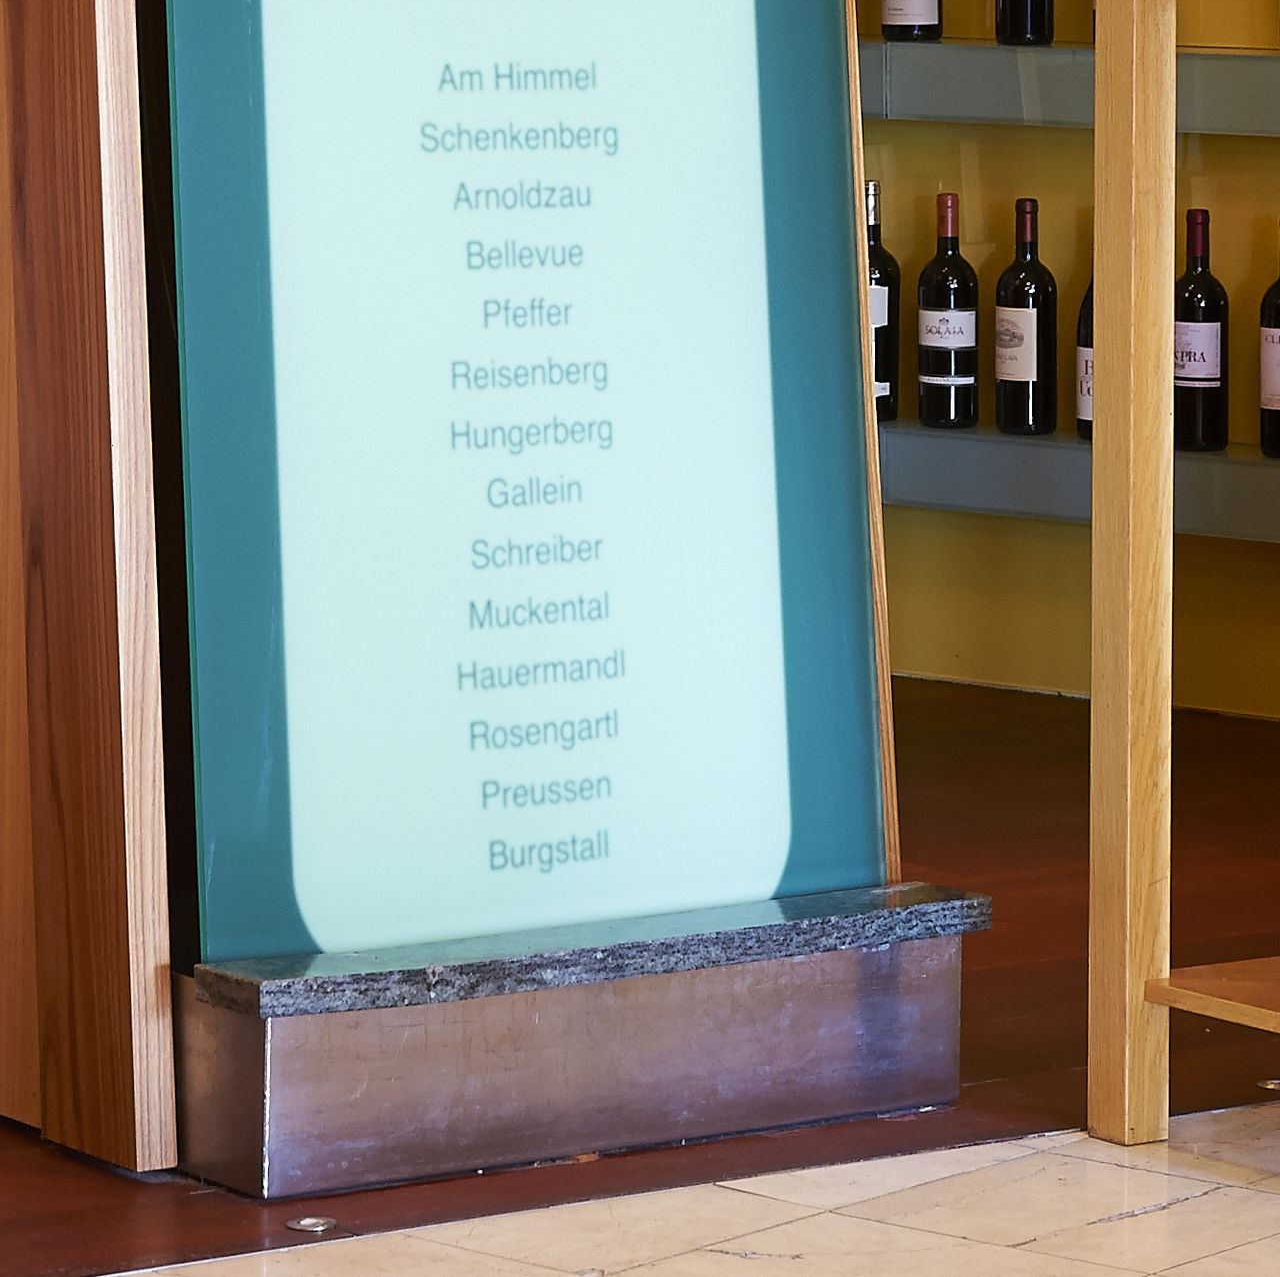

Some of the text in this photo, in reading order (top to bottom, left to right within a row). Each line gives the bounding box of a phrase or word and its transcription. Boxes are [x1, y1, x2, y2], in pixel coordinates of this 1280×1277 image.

[438, 62, 597, 93] Am Himmel
[420, 122, 619, 156] Schenkenberg
[453, 180, 592, 210] Arnoldzau
[465, 240, 584, 270] Bellevue
[482, 298, 573, 329] Pfeffer
[451, 357, 609, 391] Reisenberg
[450, 417, 613, 455] Hungerberg
[486, 476, 583, 509] Gallein
[471, 535, 603, 570] Schreiber
[468, 591, 610, 630] Muckental
[457, 649, 626, 691] Hauermandl
[470, 709, 620, 751] Rosengartl
[481, 775, 612, 811] Preussen
[488, 829, 610, 873] Burgstall
